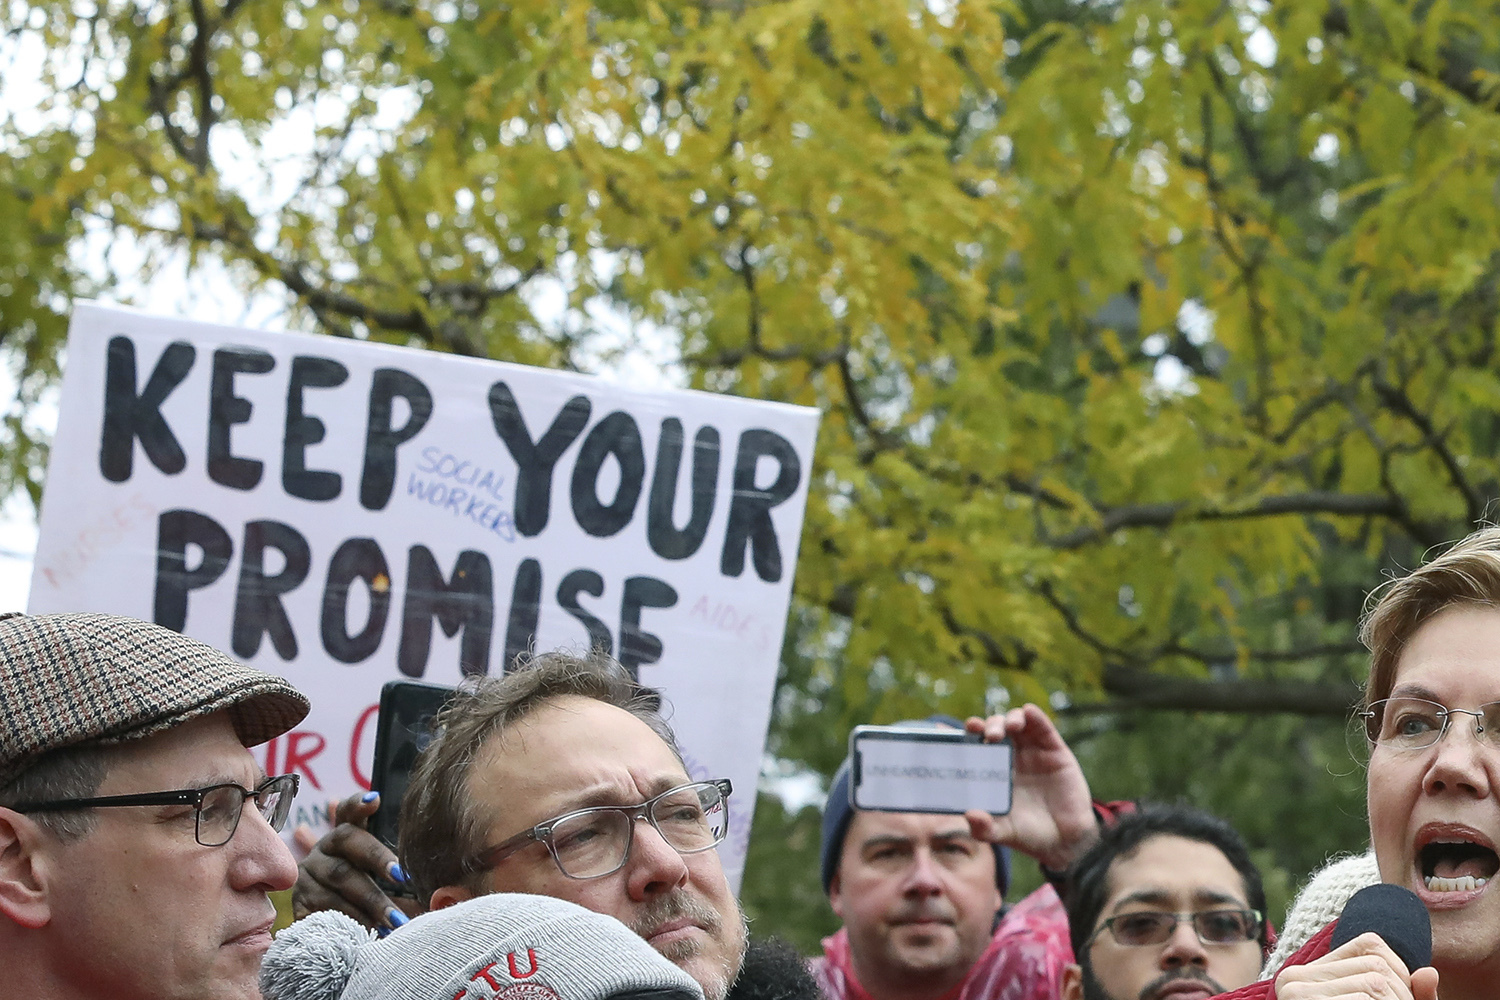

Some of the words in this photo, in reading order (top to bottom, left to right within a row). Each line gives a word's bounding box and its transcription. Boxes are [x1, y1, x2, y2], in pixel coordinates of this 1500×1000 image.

[99, 335, 434, 511] KEEP
[488, 381, 802, 583] YOUR
[416, 446, 505, 501] SOCIAL
[153, 509, 679, 711] PROMISE
